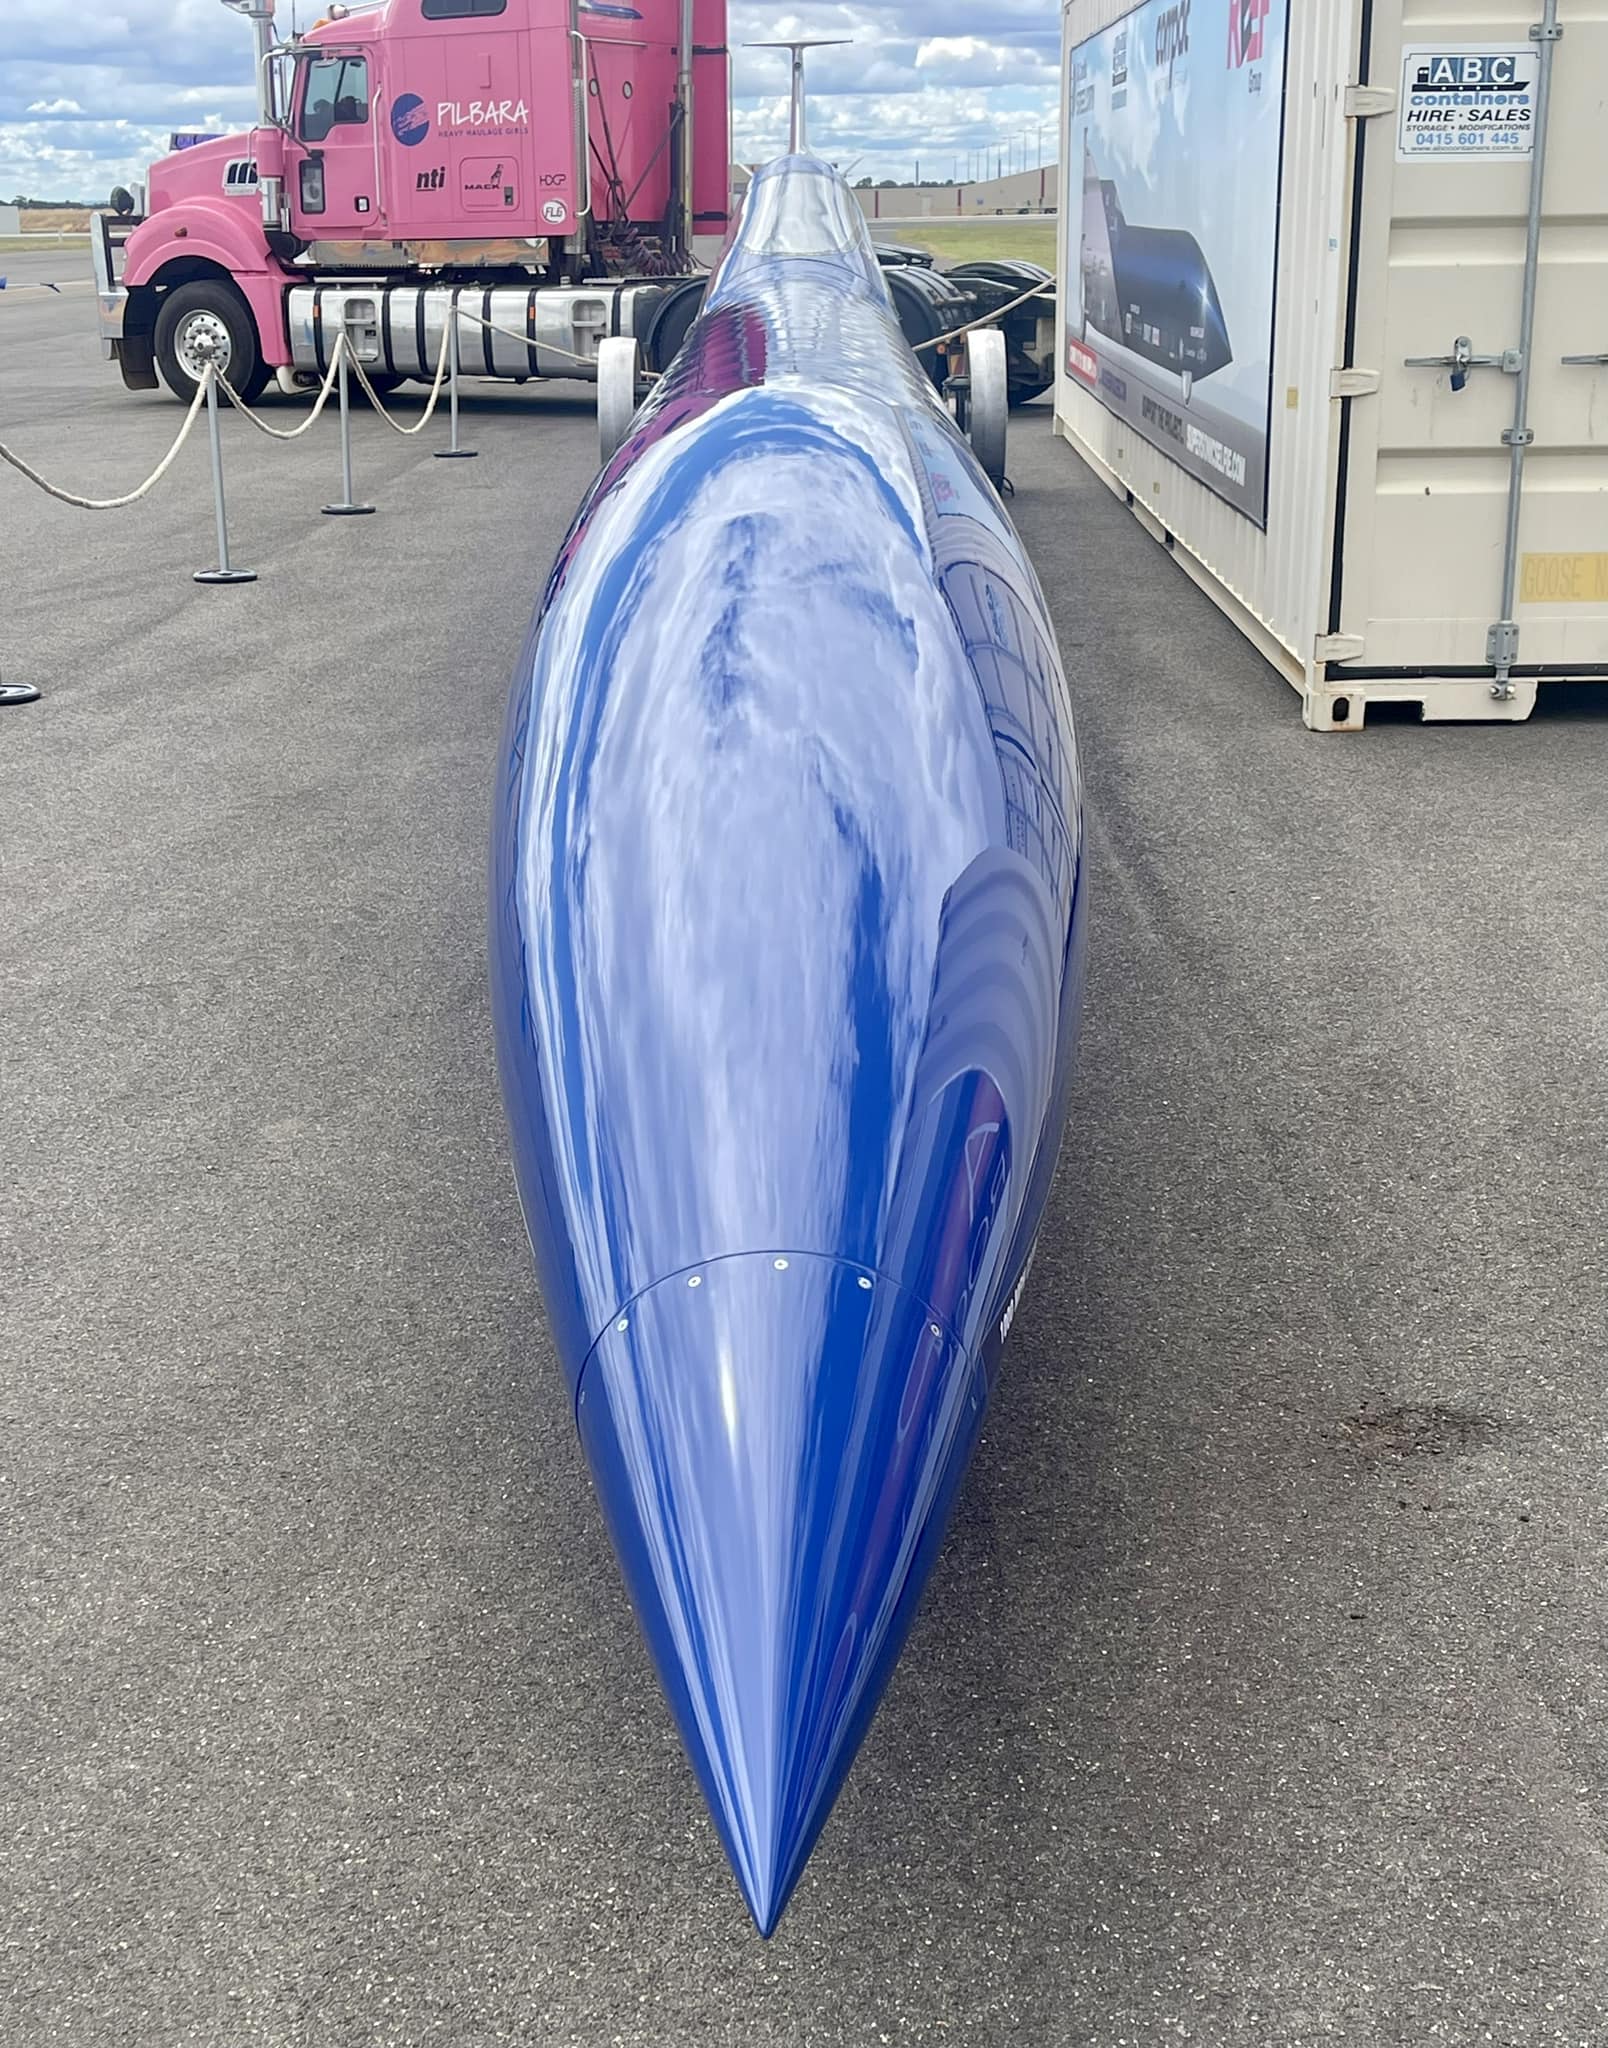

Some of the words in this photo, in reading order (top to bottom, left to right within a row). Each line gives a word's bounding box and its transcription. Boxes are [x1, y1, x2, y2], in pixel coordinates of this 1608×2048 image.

[1432, 57, 1512, 83] ABC
[1410, 91, 1530, 106] containers
[437, 99, 529, 126] PILBARA
[1407, 109, 1456, 122] HIRE
[1467, 108, 1532, 121] SALES
[438, 130, 464, 138] HEAVY
[466, 128, 503, 137] HAULAGE
[505, 127, 529, 136] GIRLS
[1406, 124, 1448, 132] STORAGE
[1458, 123, 1531, 131] MODIFICATIONS
[1416, 133, 1453, 145] 0415
[1458, 133, 1484, 145] 601
[1491, 132, 1519, 144] 445
[416, 166, 446, 189] nti
[1524, 557, 1584, 598] GOOSE
